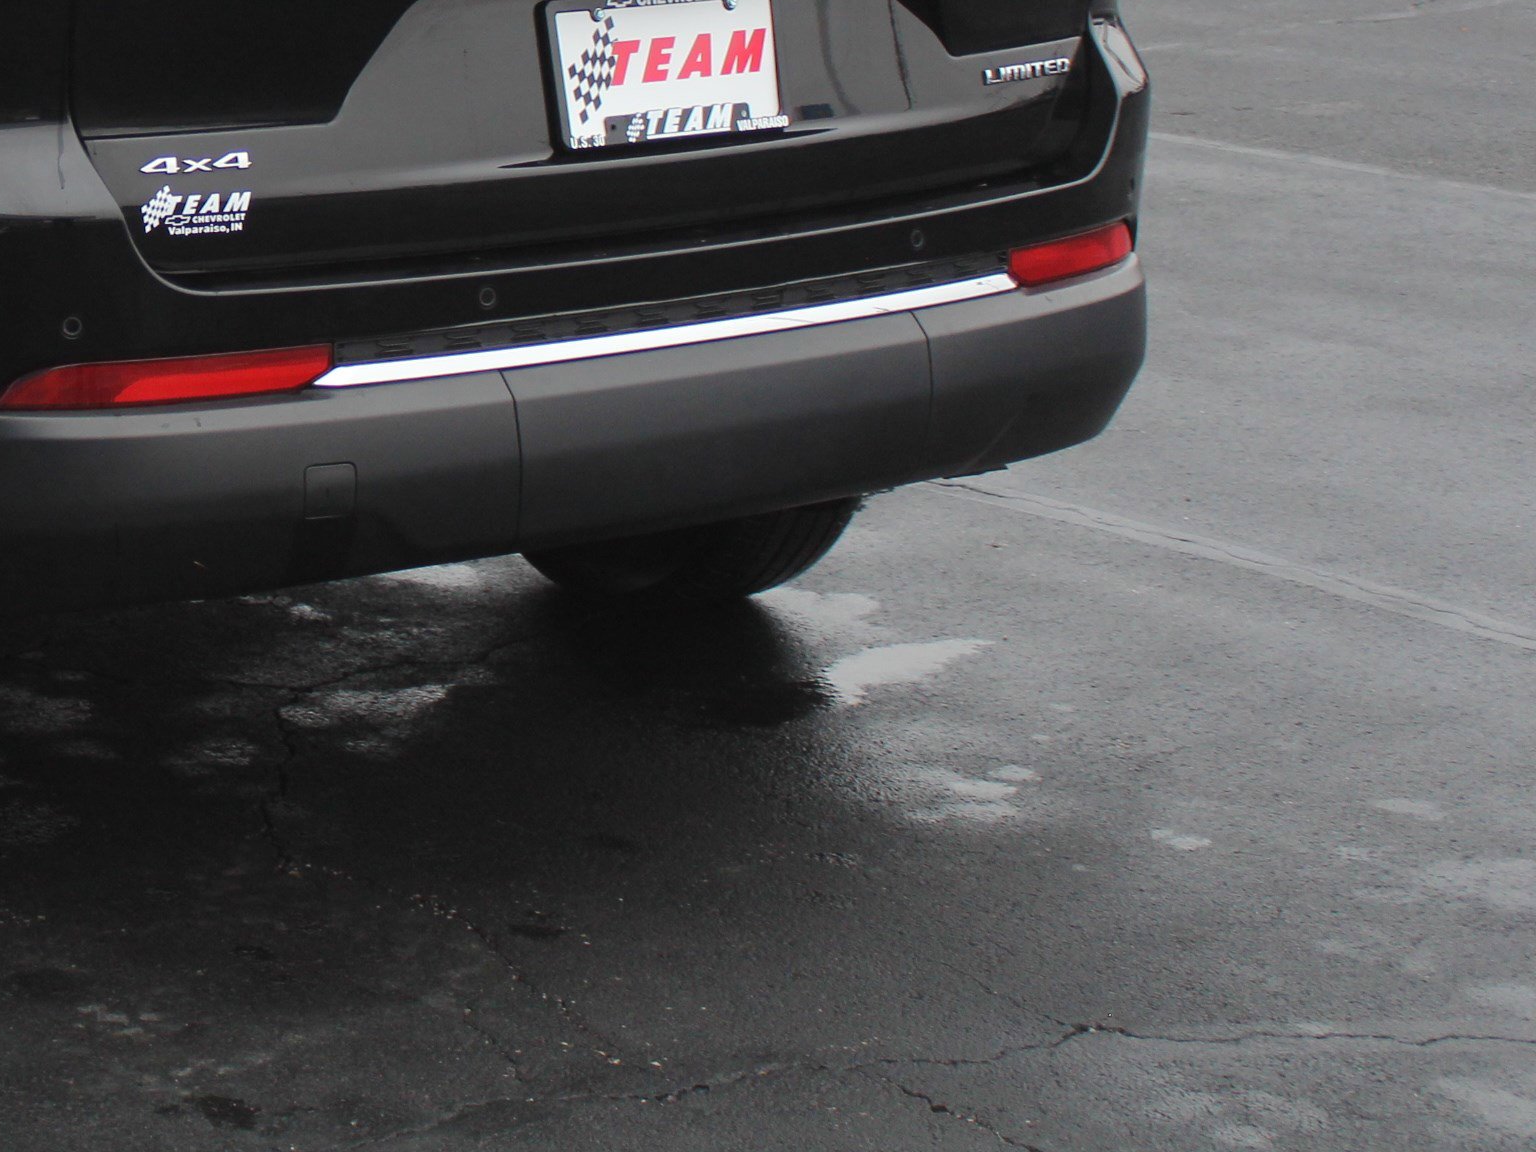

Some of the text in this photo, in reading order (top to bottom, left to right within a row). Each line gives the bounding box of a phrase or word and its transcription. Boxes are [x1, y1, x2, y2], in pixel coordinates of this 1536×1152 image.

[611, 27, 767, 86] TEAM
[983, 57, 1071, 85] LIMITED
[646, 103, 734, 136] TEAM
[736, 115, 790, 132] VALPARAISO
[570, 136, 592, 150] U.S.
[140, 151, 252, 174] 4x4
[164, 191, 252, 215] TEAM
[168, 222, 243, 236] Valparaiso, IN
[192, 213, 247, 223] CHEVROLET
